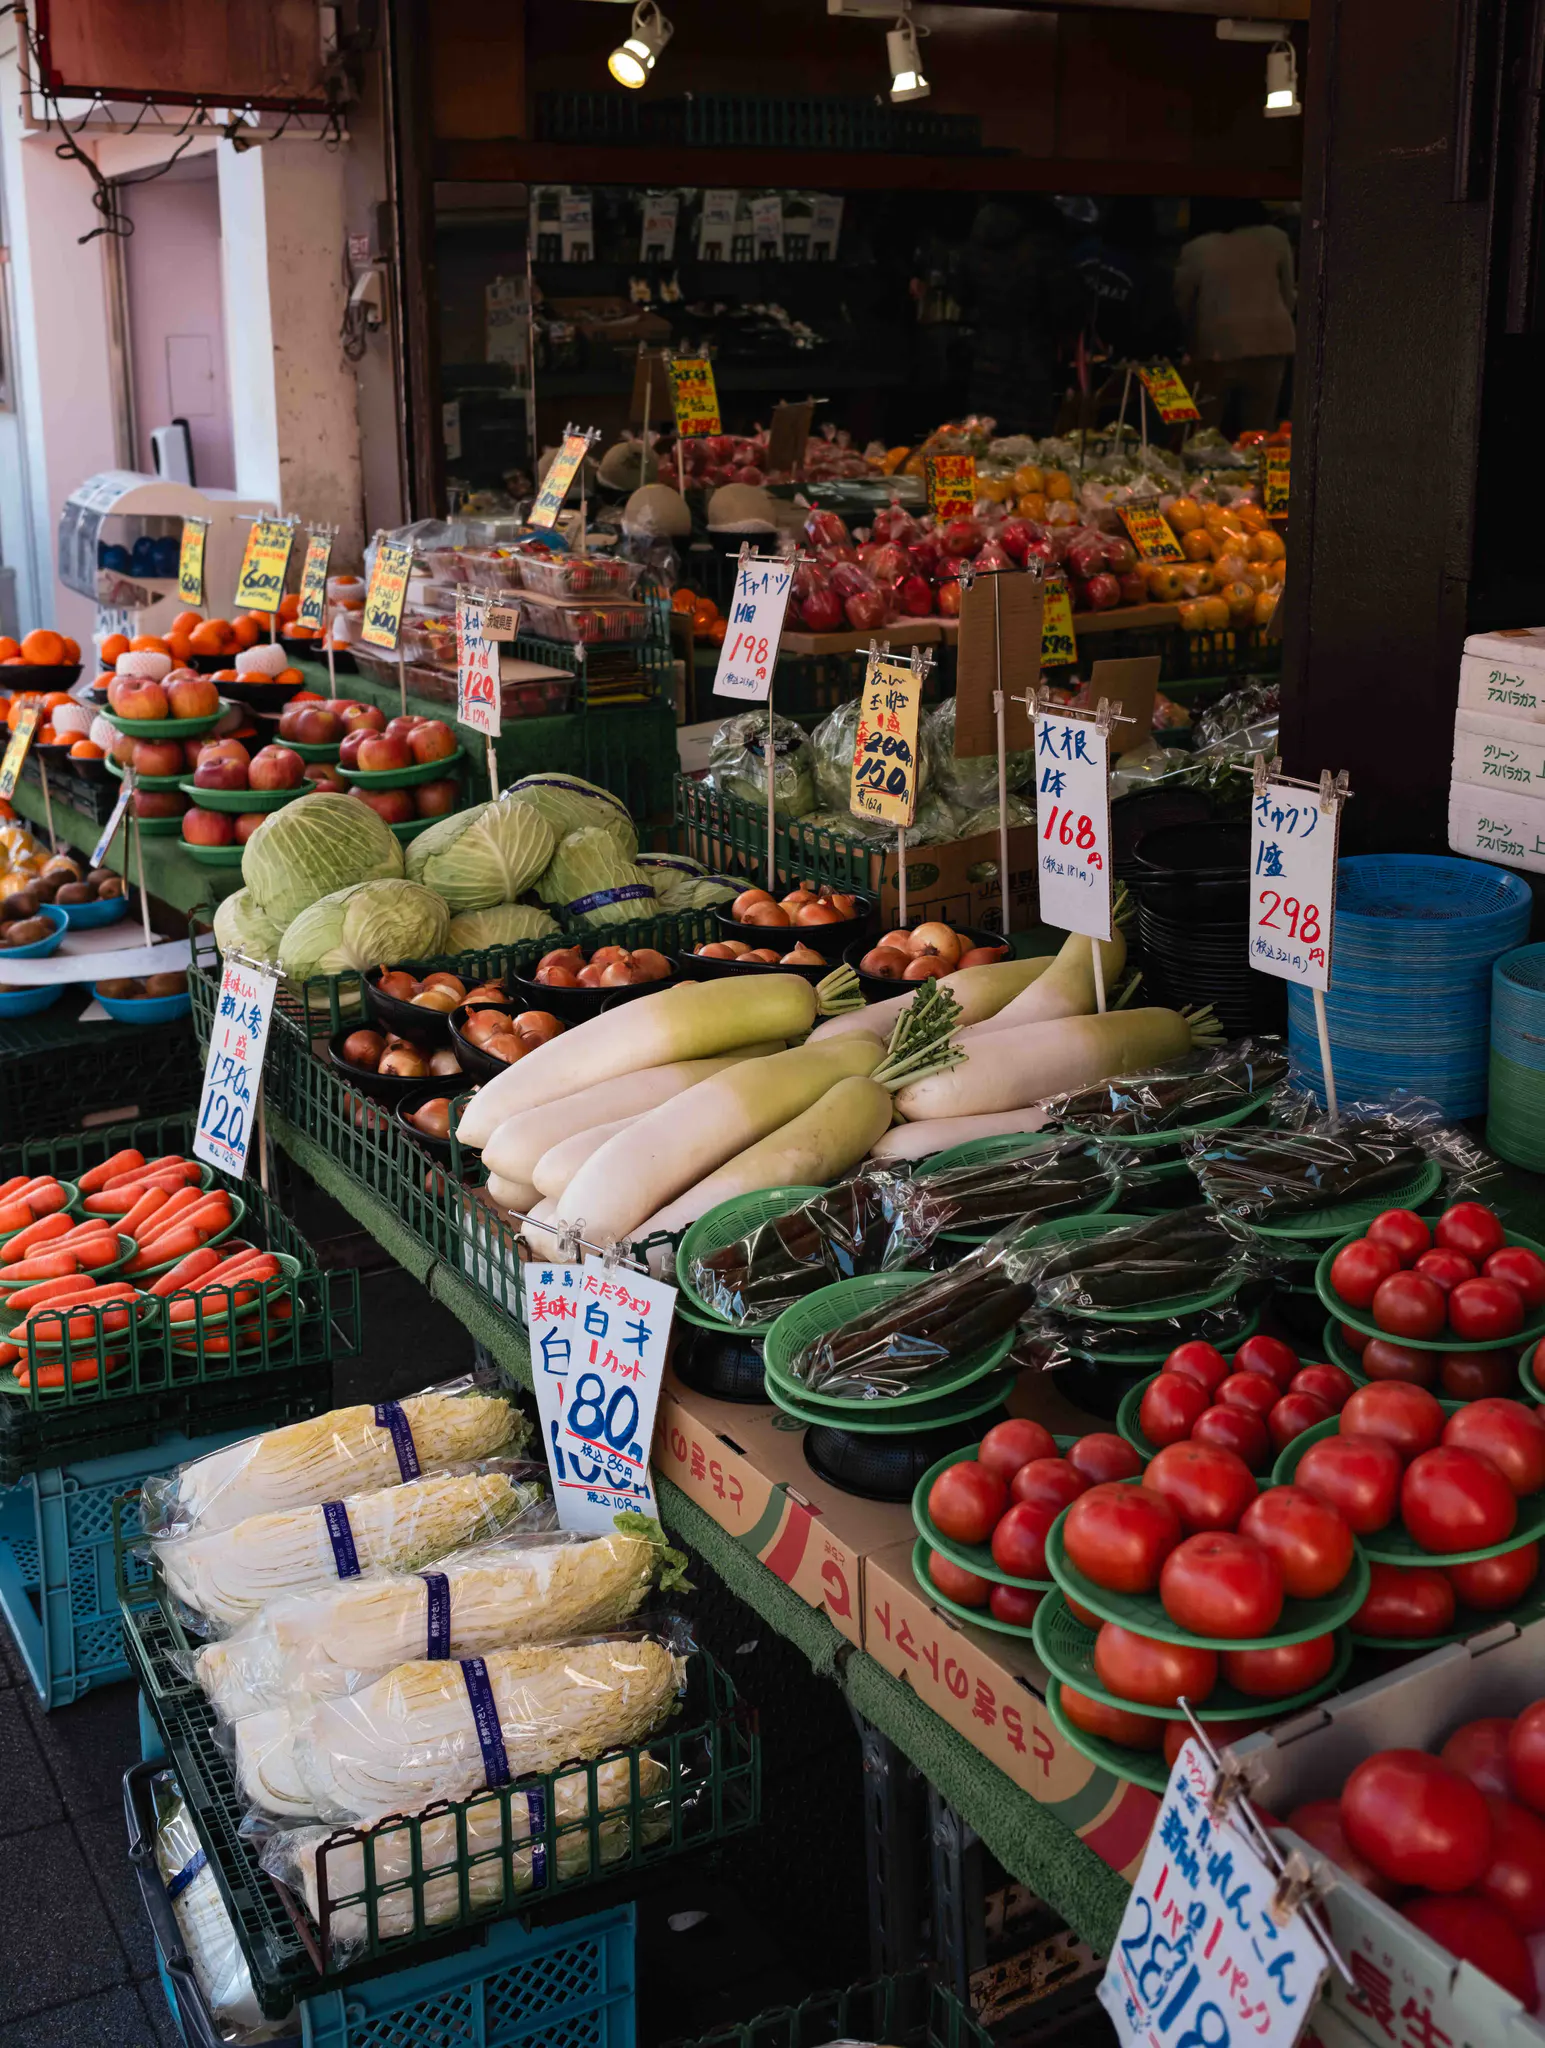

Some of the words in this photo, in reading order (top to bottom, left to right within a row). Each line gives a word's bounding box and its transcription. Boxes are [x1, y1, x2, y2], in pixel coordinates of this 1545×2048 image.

[1489, 670, 1525, 688] グリーン
[1487, 687, 1537, 709] アスパラガス
[1038, 721, 1098, 766] 大根
[1483, 744, 1519, 763] グリーン
[1040, 767, 1067, 798] 1本
[1482, 761, 1531, 783] アスパラガス
[1255, 792, 1319, 838] きゅうり
[1477, 817, 1513, 837] グリーン
[1476, 834, 1525, 857] アスパラガス
[222, 969, 257, 1000] 美味しい
[219, 994, 263, 1040] 新人参
[539, 1270, 583, 1289] 群馬
[584, 1274, 652, 1318] ただ今より
[404, 1438, 418, 1473] 新鮮やさい
[328, 1506, 342, 1538] 新鮮やさい
[824, 1540, 846, 1567] とちぎ
[431, 1598, 440, 1638] 新鮮やさい
[440, 1584, 448, 1636] VEGETABLES
[467, 1670, 480, 1697] FRESH
[873, 1600, 1056, 1777] とちぎのトマト
[475, 1703, 493, 1745] 新鮮やさい
[482, 1687, 502, 1742] VEGETABLES
